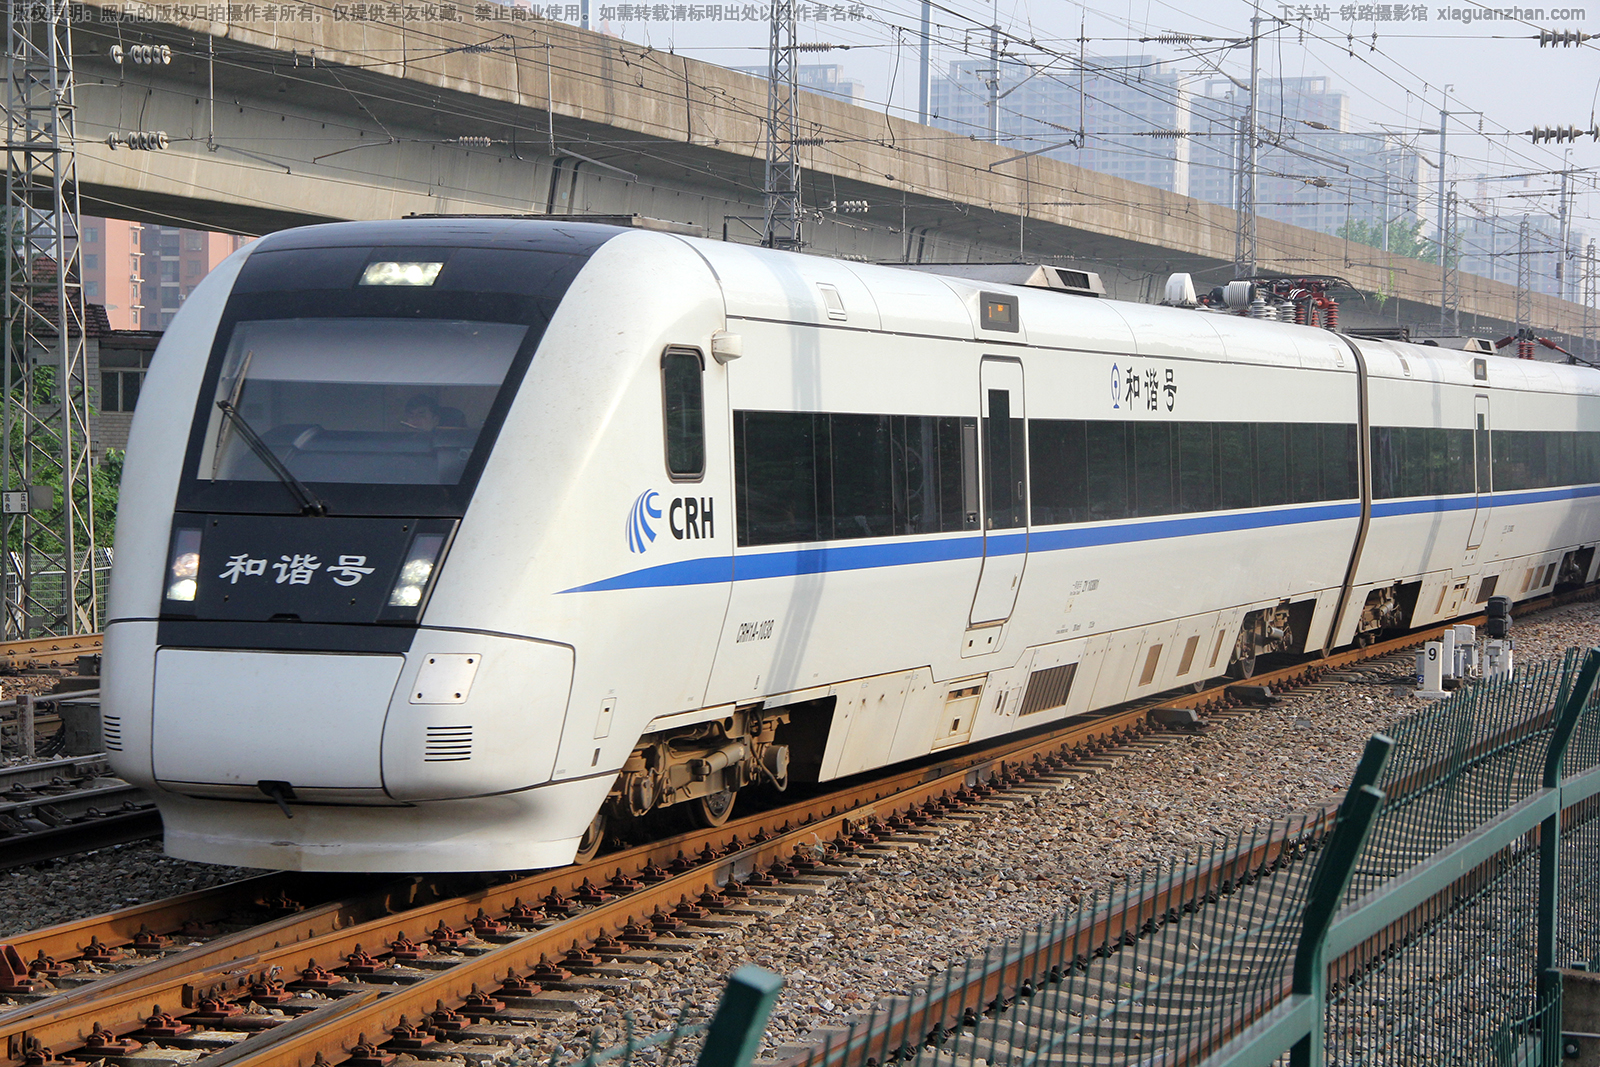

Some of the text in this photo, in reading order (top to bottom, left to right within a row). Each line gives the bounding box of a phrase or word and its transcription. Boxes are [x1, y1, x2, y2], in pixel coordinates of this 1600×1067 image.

[1125, 366, 1177, 412] 和谐号
[669, 497, 714, 540] CRH
[218, 553, 376, 587] 和谐号
[1428, 647, 1437, 661] 9
